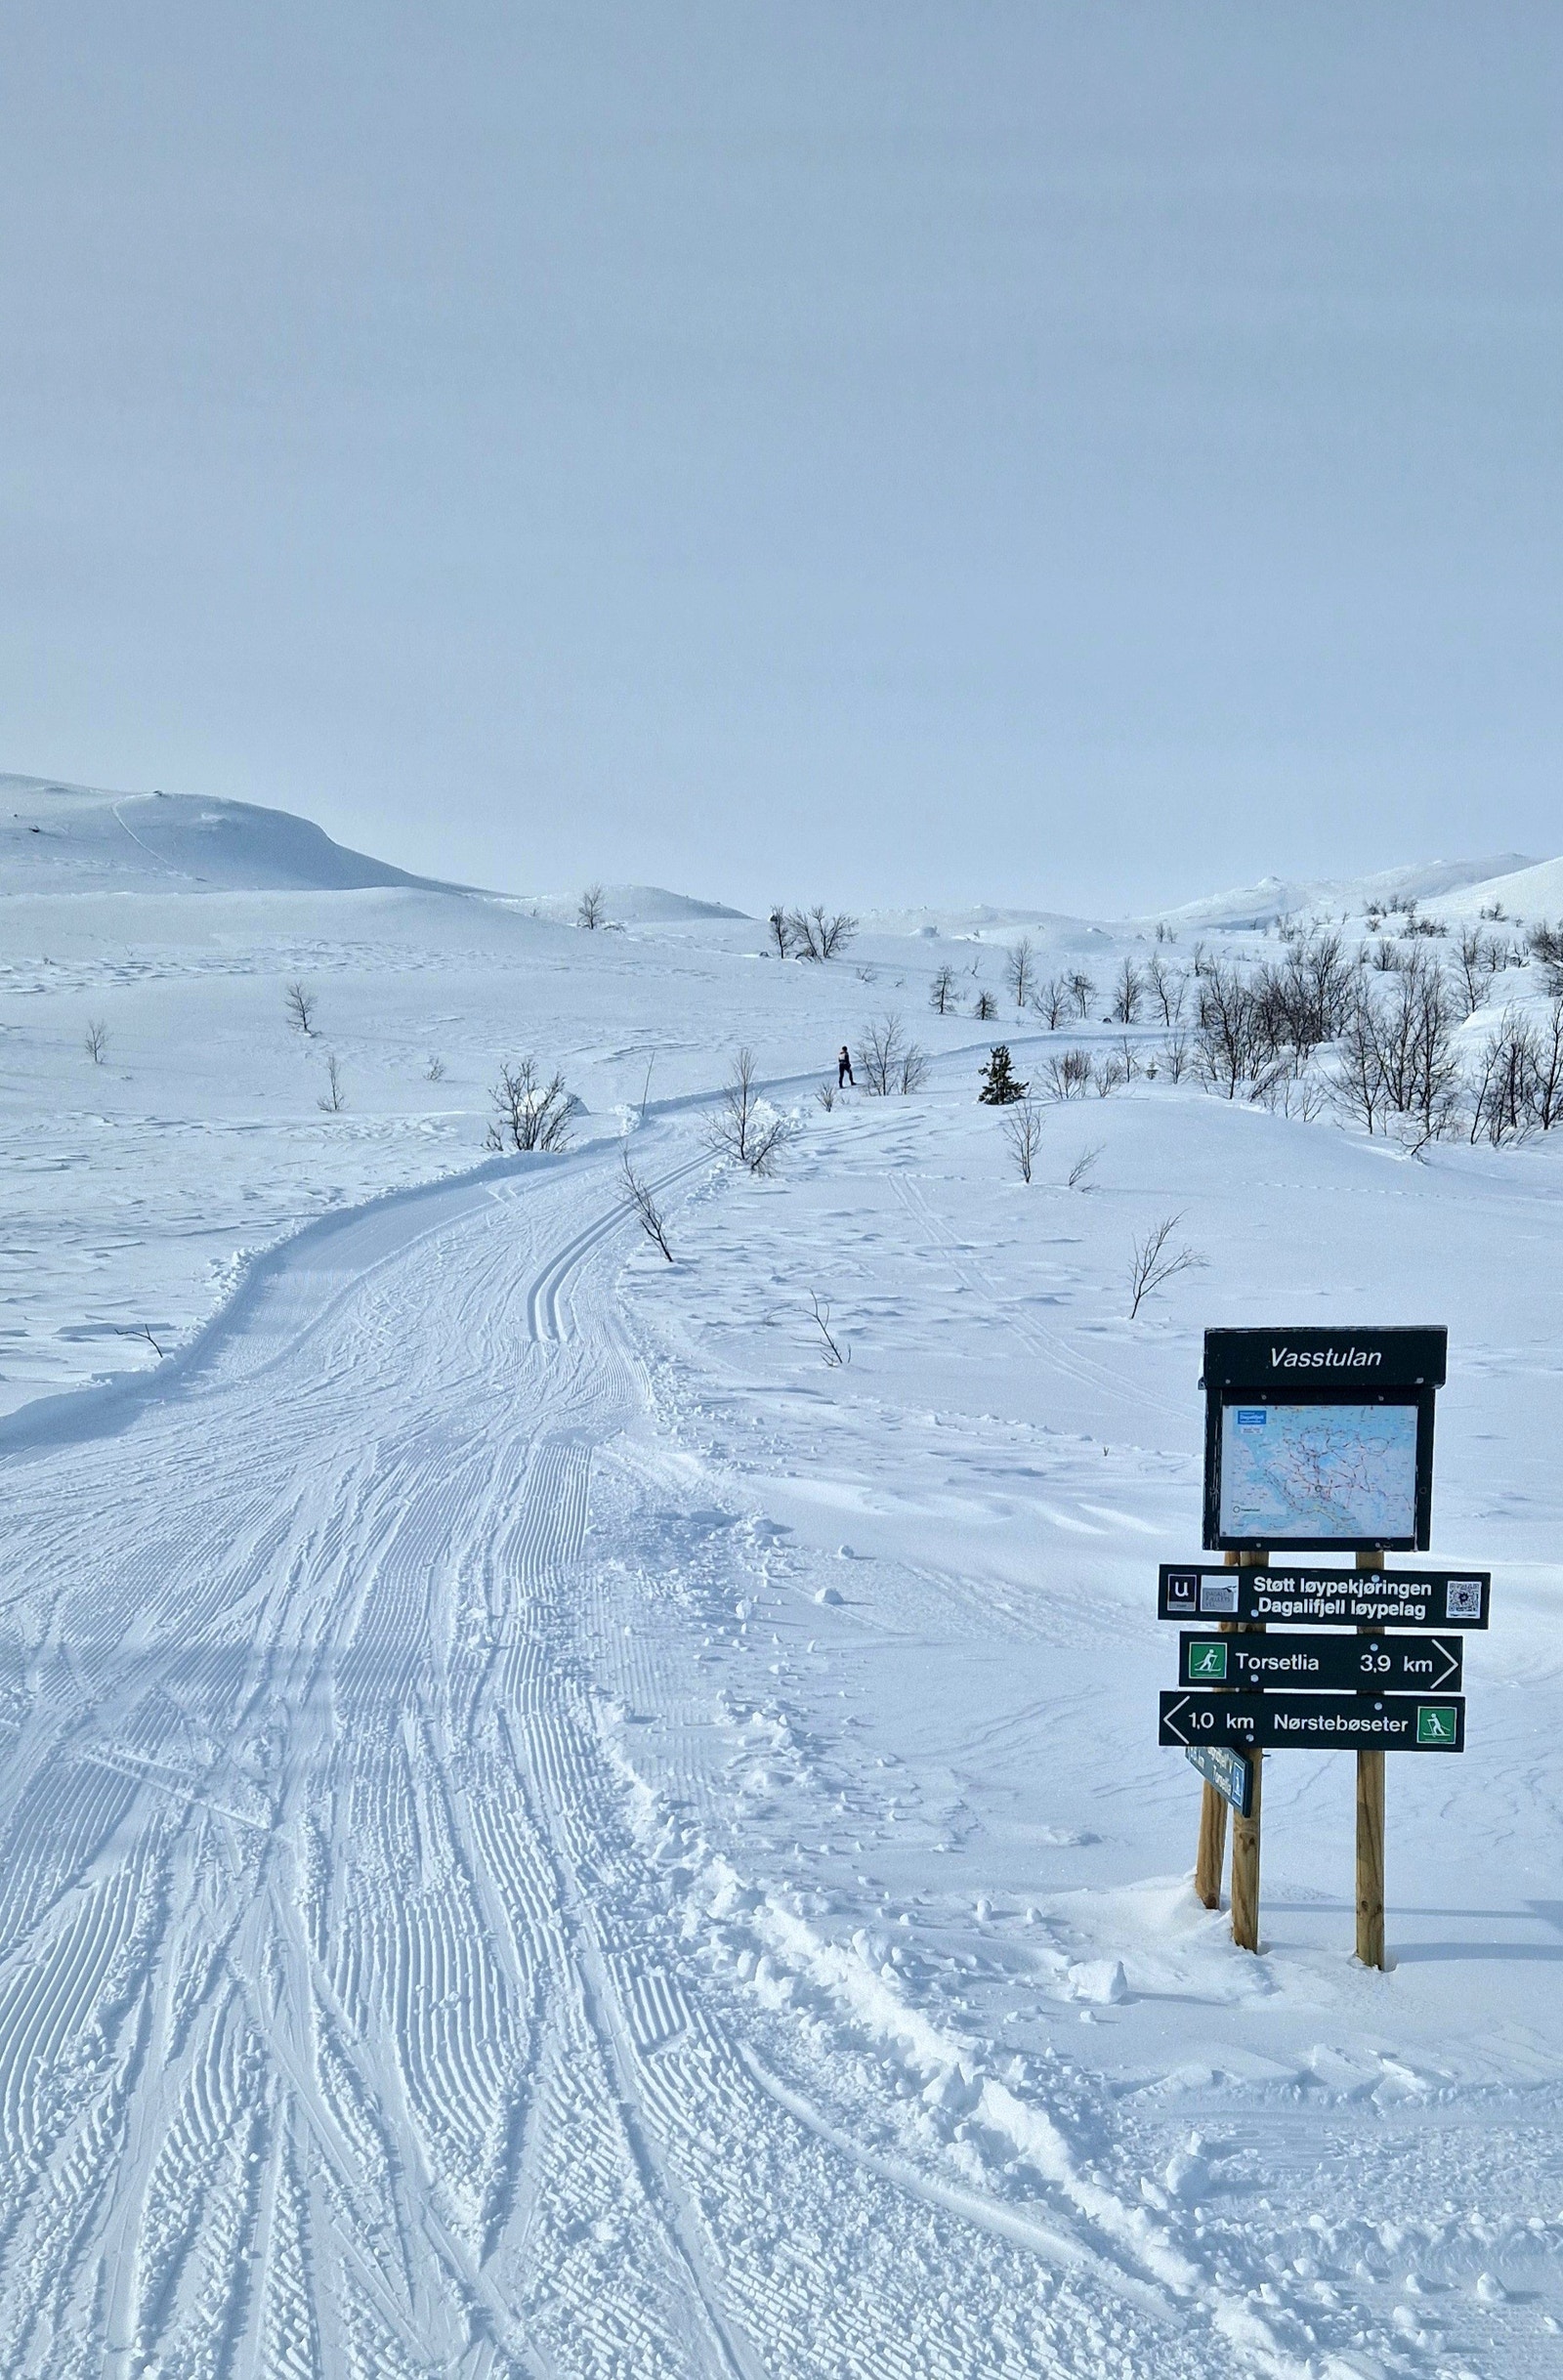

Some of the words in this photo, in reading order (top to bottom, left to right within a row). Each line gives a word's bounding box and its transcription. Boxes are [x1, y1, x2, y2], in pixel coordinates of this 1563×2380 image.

[1271, 1347, 1382, 1367] Vasstulan
[1253, 1576, 1295, 1593] Støtt
[1300, 1577, 1432, 1599] løypekjøringen
[1258, 1596, 1346, 1618] Dagalifjell
[1351, 1599, 1426, 1620] løypelag
[1235, 1652, 1320, 1671] Torsetlia
[1360, 1654, 1391, 1674] 3,9
[1403, 1655, 1433, 1673] km
[1188, 1712, 1214, 1729] 1,0
[1226, 1713, 1254, 1729] km
[1274, 1714, 1409, 1732] Nørstebøseter
